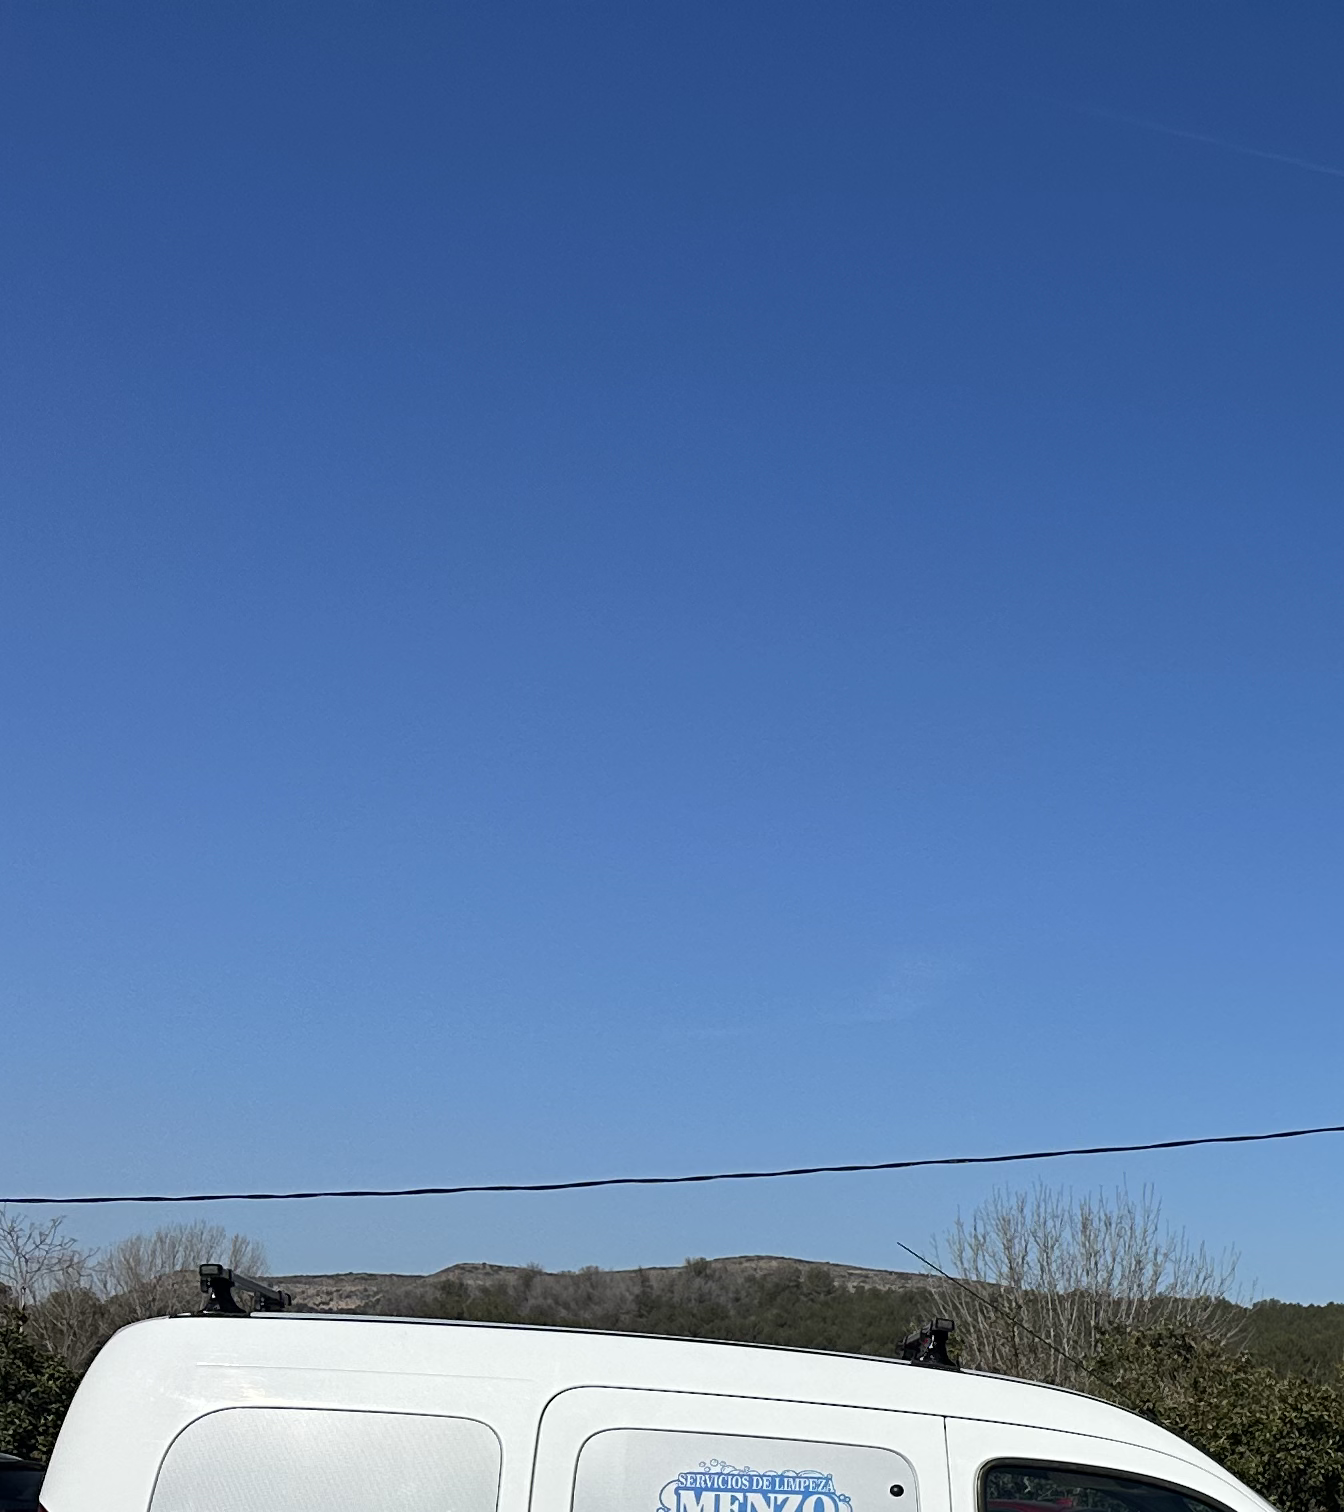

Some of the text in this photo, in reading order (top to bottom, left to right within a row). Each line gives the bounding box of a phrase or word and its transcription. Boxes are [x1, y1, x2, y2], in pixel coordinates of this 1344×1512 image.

[678, 1474, 835, 1492] SERVICIOS DE LIMPEZA
